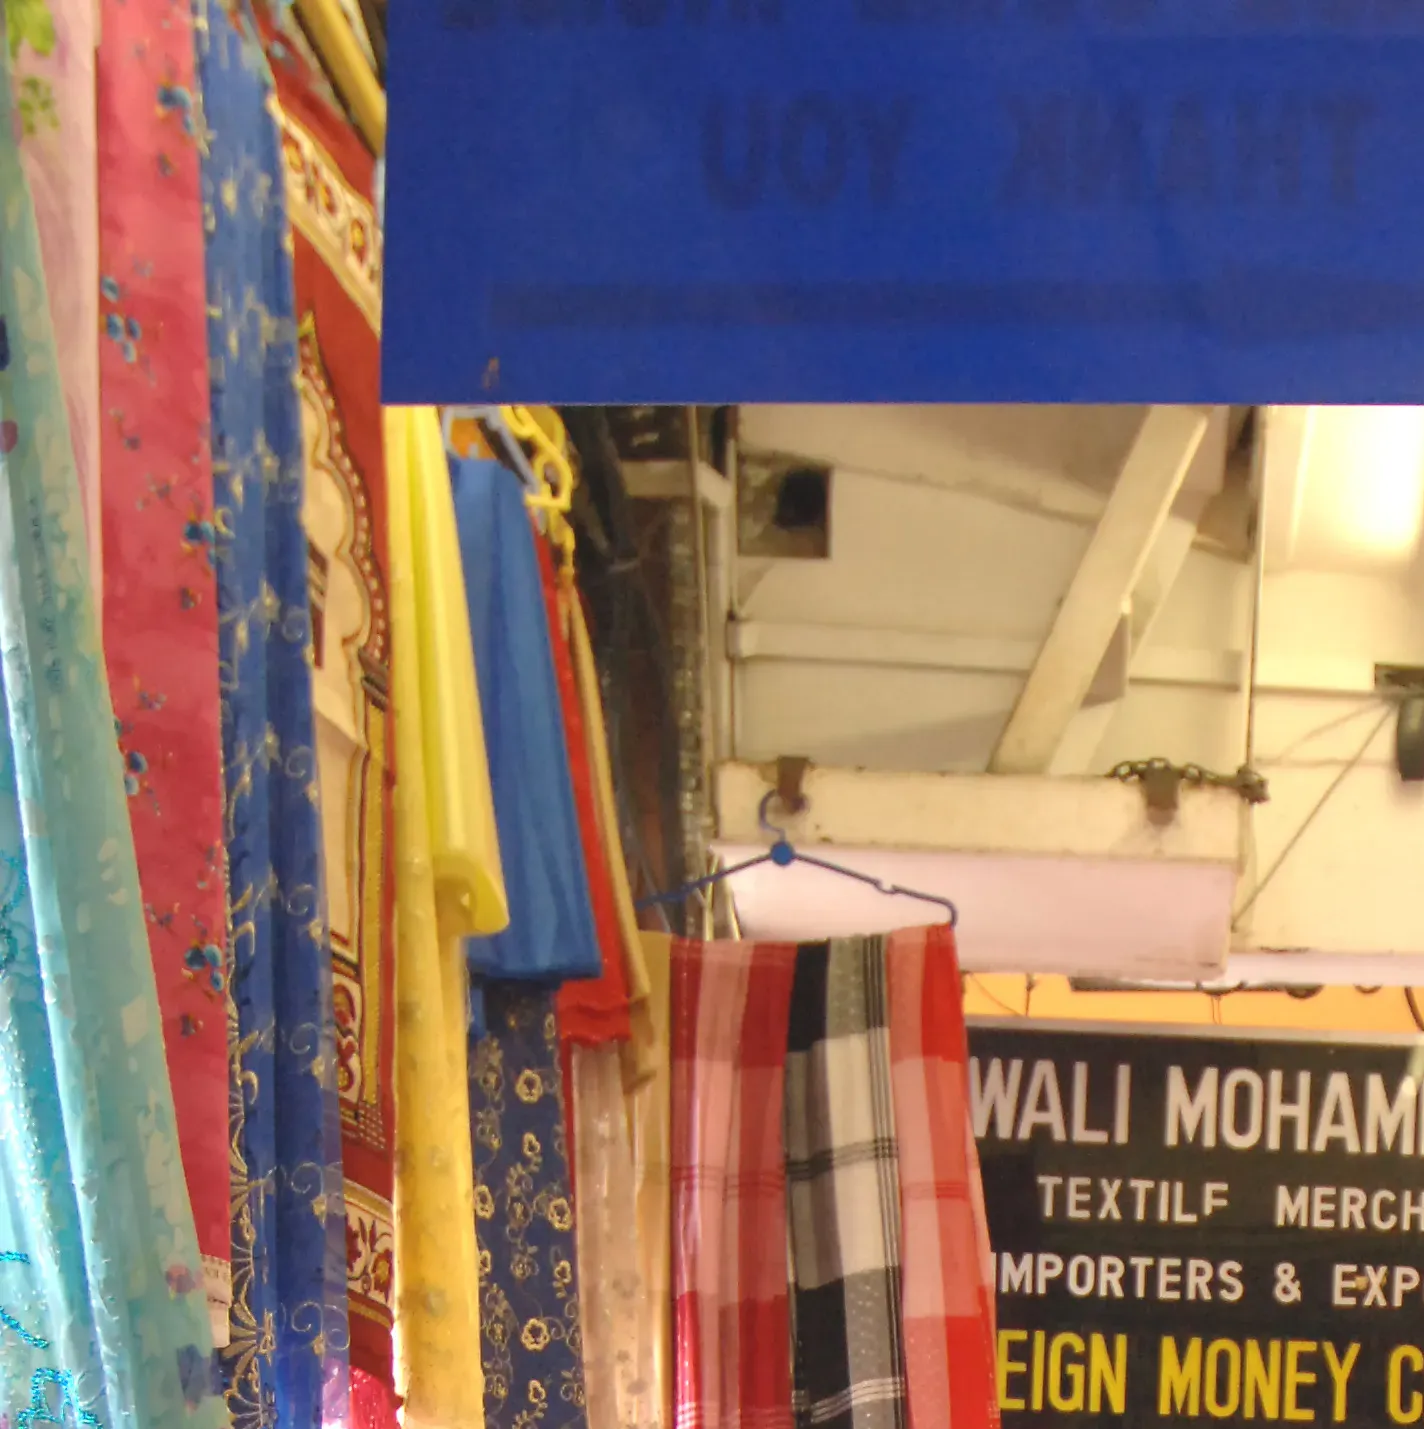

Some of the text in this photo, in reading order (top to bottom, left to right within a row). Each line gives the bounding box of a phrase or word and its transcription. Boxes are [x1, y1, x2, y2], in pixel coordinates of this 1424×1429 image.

[971, 1056, 1130, 1146] WALI
[1274, 1263, 1302, 1303] &
[1158, 1336, 1361, 1423] MONEY
